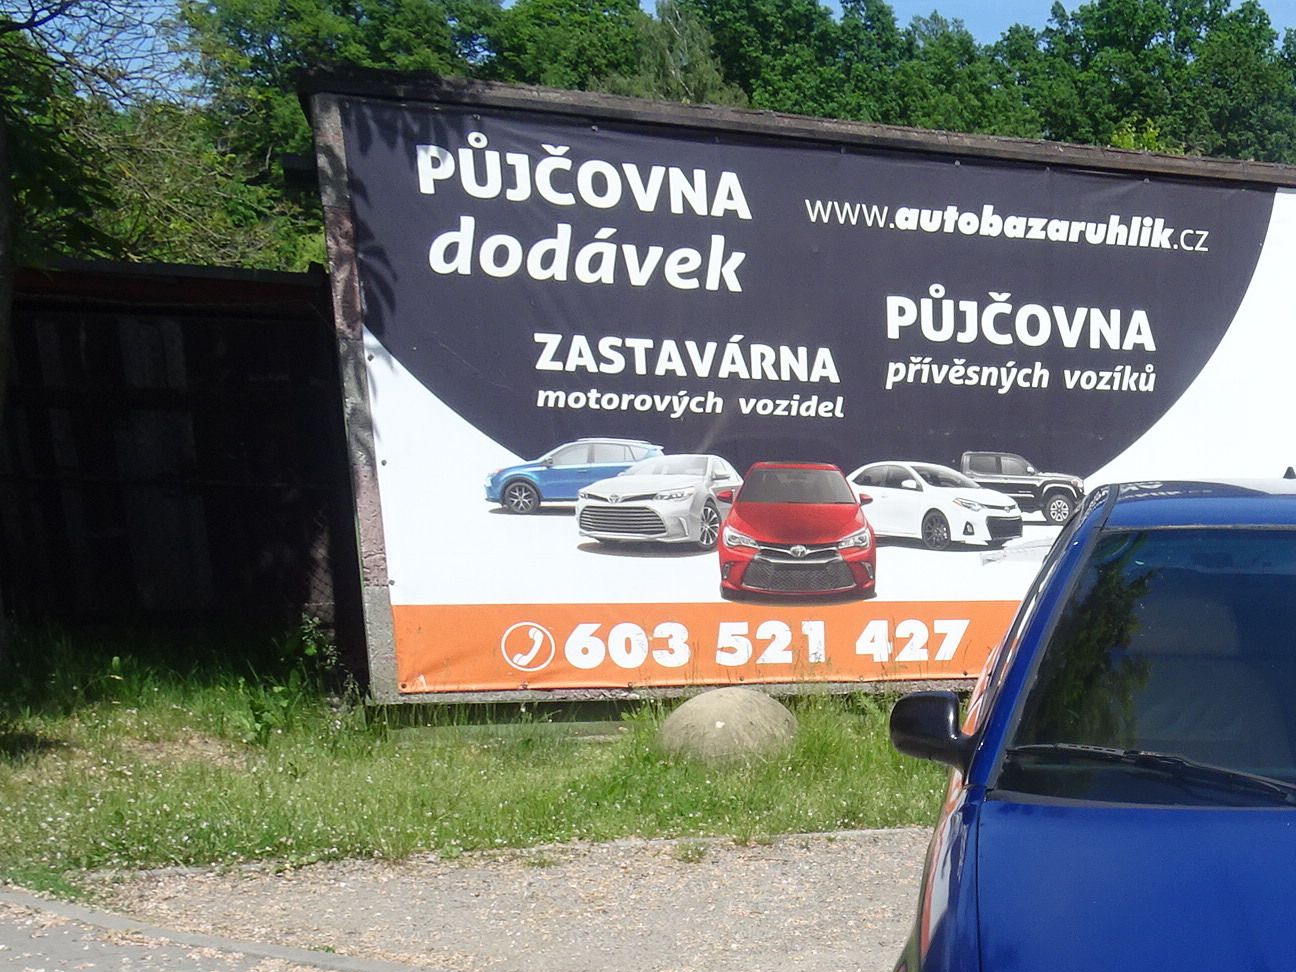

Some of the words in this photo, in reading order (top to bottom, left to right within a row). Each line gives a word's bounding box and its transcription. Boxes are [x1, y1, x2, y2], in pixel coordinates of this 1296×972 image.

[417, 130, 752, 220] PŮJČOVNA
[805, 199, 1209, 251] www.autobazaruhlik.cz
[429, 216, 746, 292] dodávek
[887, 284, 1156, 351] PŮJČOVNA
[534, 333, 840, 383] ZASTAVÁRNA
[886, 357, 1049, 394] přívěsných
[1064, 364, 1156, 392] vozíků
[537, 389, 723, 418] motorových
[739, 395, 844, 418] vozidel
[564, 622, 691, 669] 603
[716, 620, 825, 667] 521
[855, 619, 970, 662] 427
